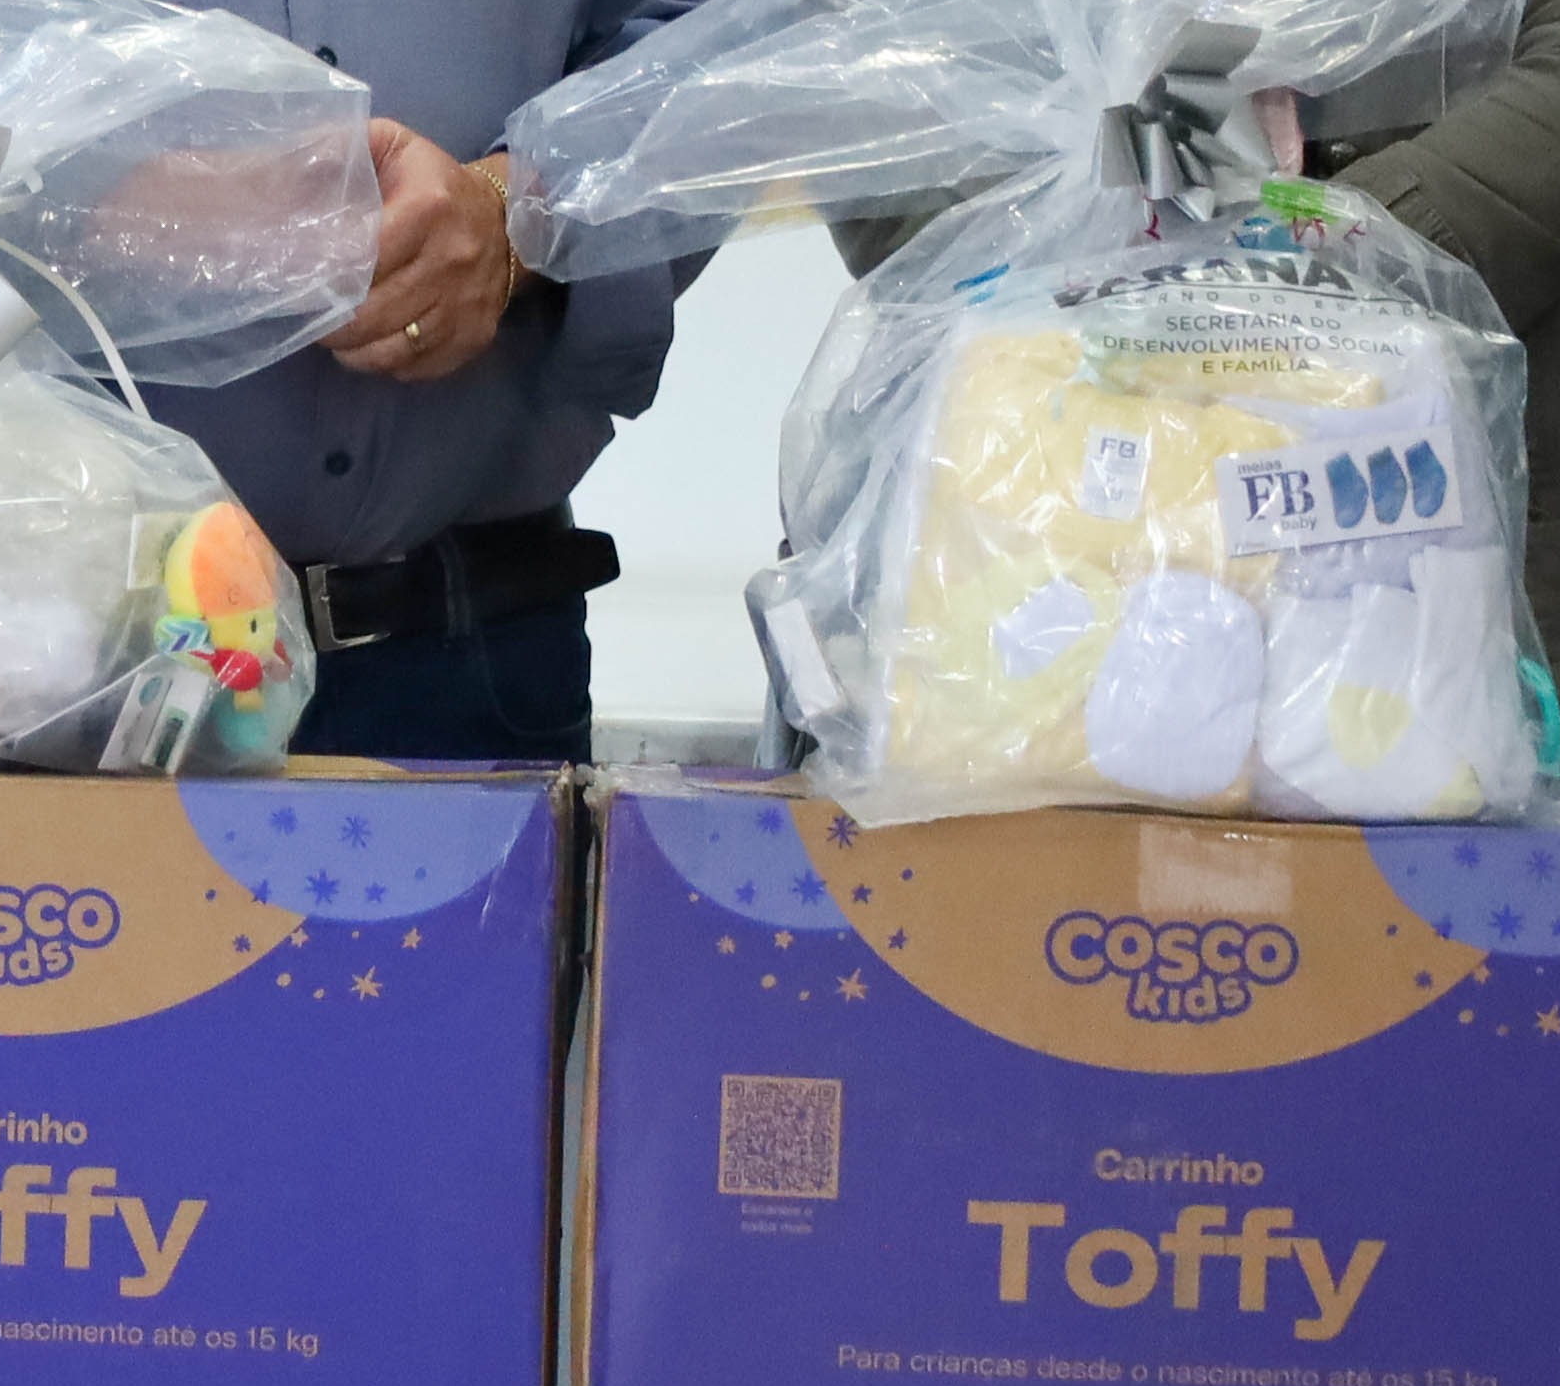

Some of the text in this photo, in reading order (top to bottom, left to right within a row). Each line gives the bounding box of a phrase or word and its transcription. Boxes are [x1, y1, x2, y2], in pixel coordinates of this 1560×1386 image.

[1165, 313, 1341, 332] SECRETARIA DO
[1102, 334, 1405, 357] DESENVOLVIMENTO SOCIAL
[1202, 357, 1311, 374] E FAMÍLIA
[1237, 459, 1282, 474] meias
[1240, 470, 1315, 521] FB
[1280, 514, 1318, 531] baby
[1125, 975, 1252, 1025] kids
[1093, 1146, 1264, 1188] Carrinho
[966, 1200, 1387, 1342] Toffy
[153, 1323, 196, 1347] até
[205, 1329, 237, 1349] os
[247, 1327, 276, 1350] 15
[286, 1328, 319, 1357] kg
[838, 1344, 901, 1372] Para
[909, 1350, 1027, 1380] crianças
[1036, 1355, 1122, 1382] desde
[1131, 1364, 1148, 1383] o
